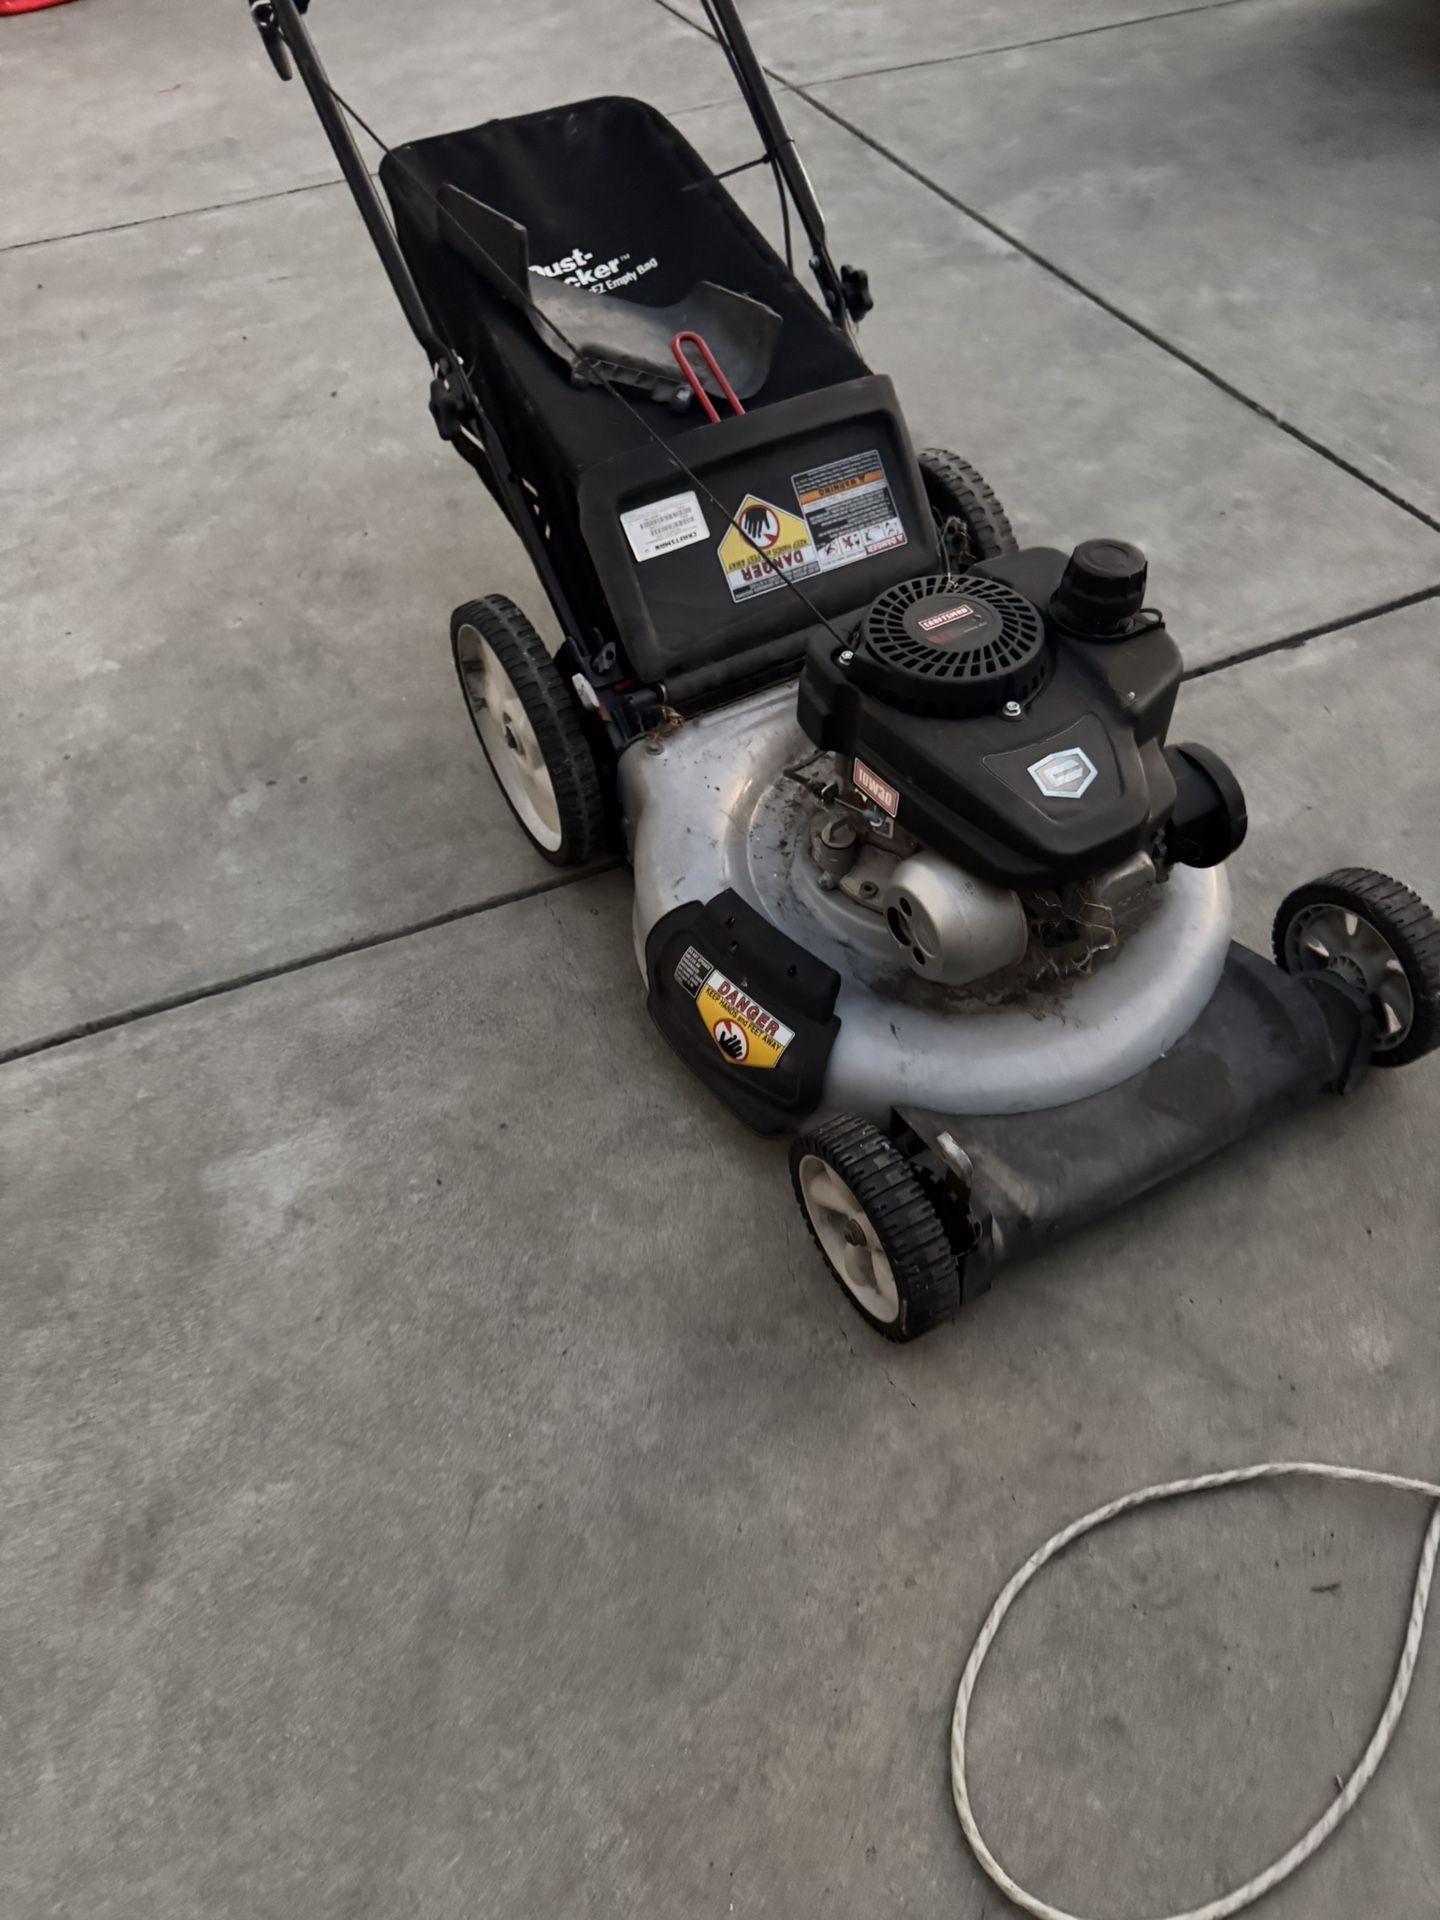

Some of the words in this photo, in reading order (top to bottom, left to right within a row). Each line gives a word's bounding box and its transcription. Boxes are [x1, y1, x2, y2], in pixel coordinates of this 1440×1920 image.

[605, 270, 637, 290] Empty
[636, 257, 658, 275] Bag
[740, 550, 804, 582] DANGER
[858, 768, 893, 807] 10W30
[705, 986, 720, 1004] KEEP
[718, 998, 739, 1019] HANDS
[747, 1018, 764, 1039] FEET
[761, 1031, 781, 1052] AWAY
[717, 980, 780, 1037] DANGER
